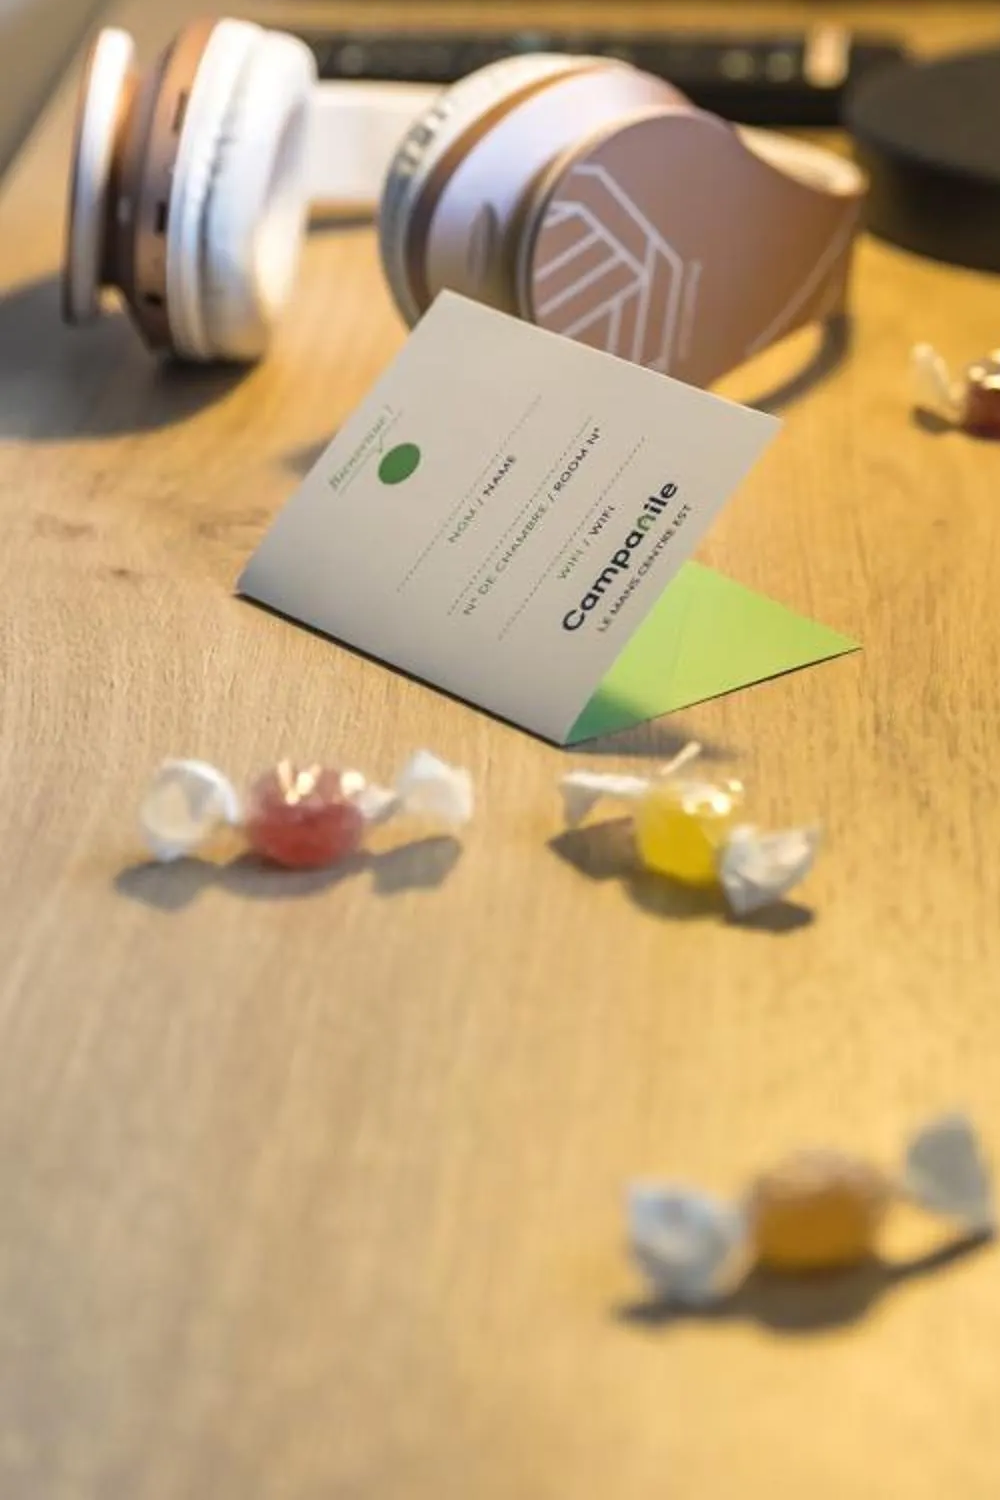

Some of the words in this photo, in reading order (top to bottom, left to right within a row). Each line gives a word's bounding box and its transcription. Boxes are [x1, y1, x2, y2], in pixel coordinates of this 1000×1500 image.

[448, 508, 476, 543] NOM
[483, 454, 517, 496] NAME
[478, 575, 495, 596] DE
[495, 505, 548, 573] CHAMBRE
[554, 449, 589, 492] ROOM
[562, 482, 678, 632] Campanile
[597, 617, 611, 633] LE
[610, 577, 640, 615] MANS
[638, 529, 675, 576] CENTRE
[672, 504, 692, 527] EST
